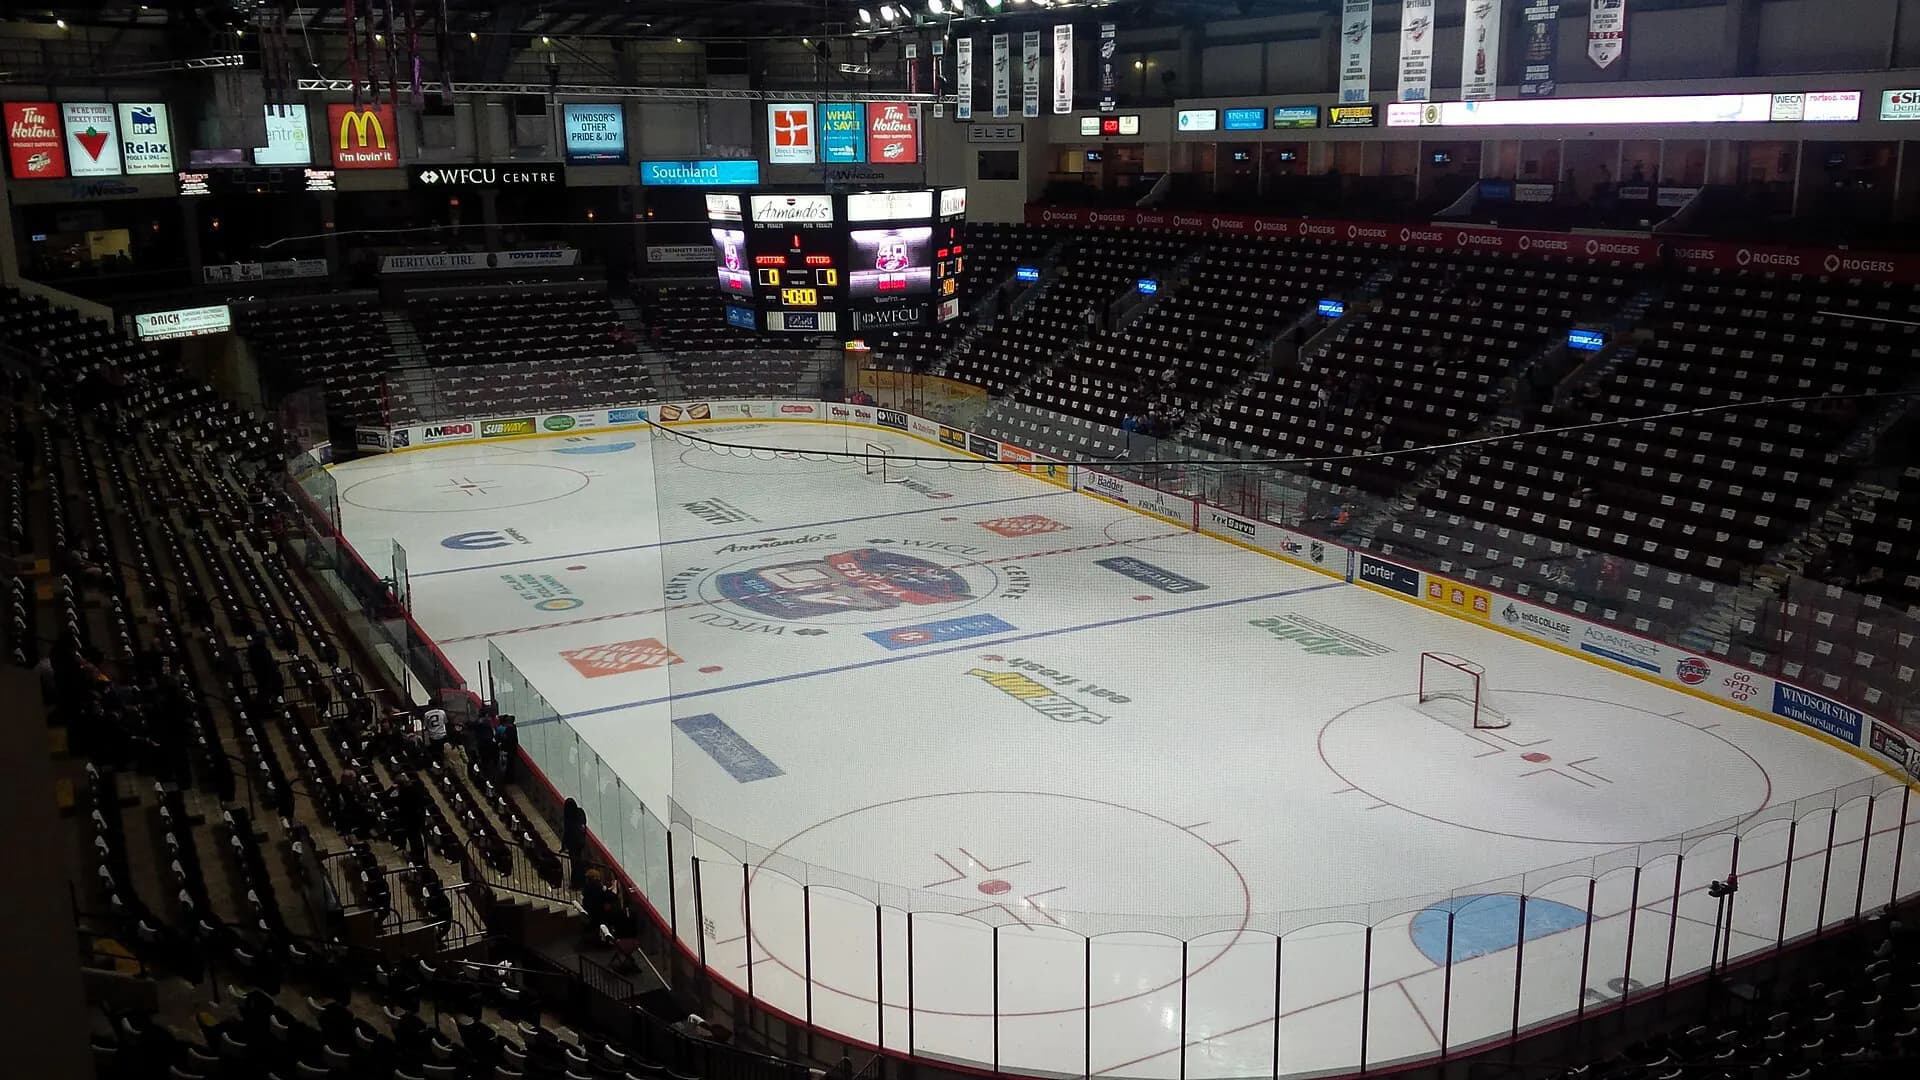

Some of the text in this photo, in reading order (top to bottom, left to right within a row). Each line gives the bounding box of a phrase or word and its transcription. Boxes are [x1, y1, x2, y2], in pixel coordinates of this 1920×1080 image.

[1901, 92, 1920, 104] Sh
[22, 107, 46, 124] Tim
[571, 113, 616, 123] WINDSOR'S
[827, 111, 856, 120] WHAT
[884, 106, 903, 120] Tim
[11, 121, 56, 138] Hortons
[134, 123, 156, 134] RPS
[581, 123, 607, 132] OTHER
[824, 122, 832, 131] A
[873, 118, 913, 132] Hortons
[571, 132, 618, 141] PRIDE & JOY
[973, 128, 1016, 138] ELEC
[125, 141, 168, 154] Relax
[339, 153, 354, 161] I'm
[356, 153, 382, 161] lovin'
[440, 168, 556, 184] WFCU CENTRE
[652, 165, 718, 178] Southland
[757, 200, 829, 220] Armando's
[1099, 214, 1125, 222] ROGERS
[1219, 219, 1243, 229] ROGERS
[1262, 222, 1288, 232] ROGERS
[1308, 225, 1335, 235] ROGERS
[1358, 227, 1387, 238] ROGERS
[794, 234, 800, 248] 1
[1410, 230, 1443, 242] ROGERS
[1468, 233, 1503, 246] ROGERS
[1531, 238, 1568, 251] ROGERS
[1599, 243, 1640, 255] ROGERS
[391, 254, 476, 268] HERITAGE TIRE
[508, 251, 563, 260] TOYO TIRES
[806, 256, 831, 264] OTTERS
[1752, 253, 1800, 267] ROGERS
[1842, 258, 1895, 273] ROGERS
[769, 269, 779, 285] 0
[826, 269, 838, 285] 0
[782, 289, 817, 305] 40:00
[150, 313, 180, 326] BRICK
[876, 307, 919, 323] WFCU
[885, 411, 908, 426] WFCU
[483, 421, 528, 434] SUBWAY
[714, 533, 838, 555] Armando's
[902, 538, 986, 556] WFCU
[1362, 563, 1395, 581] porter
[665, 566, 709, 601] CENTRE
[1000, 564, 1031, 600] CENTRE
[689, 613, 786, 636] WFCU
[1539, 615, 1571, 634] COLLEGE
[1007, 657, 1132, 704] eat fresh
[1733, 671, 1751, 683] GO
[1722, 679, 1760, 696] SPITS
[1731, 690, 1749, 702] GO
[1781, 686, 1857, 727] WINDSOR STAR
[433, 710, 445, 727] 2
[1783, 705, 1855, 742] windsorstar.com
